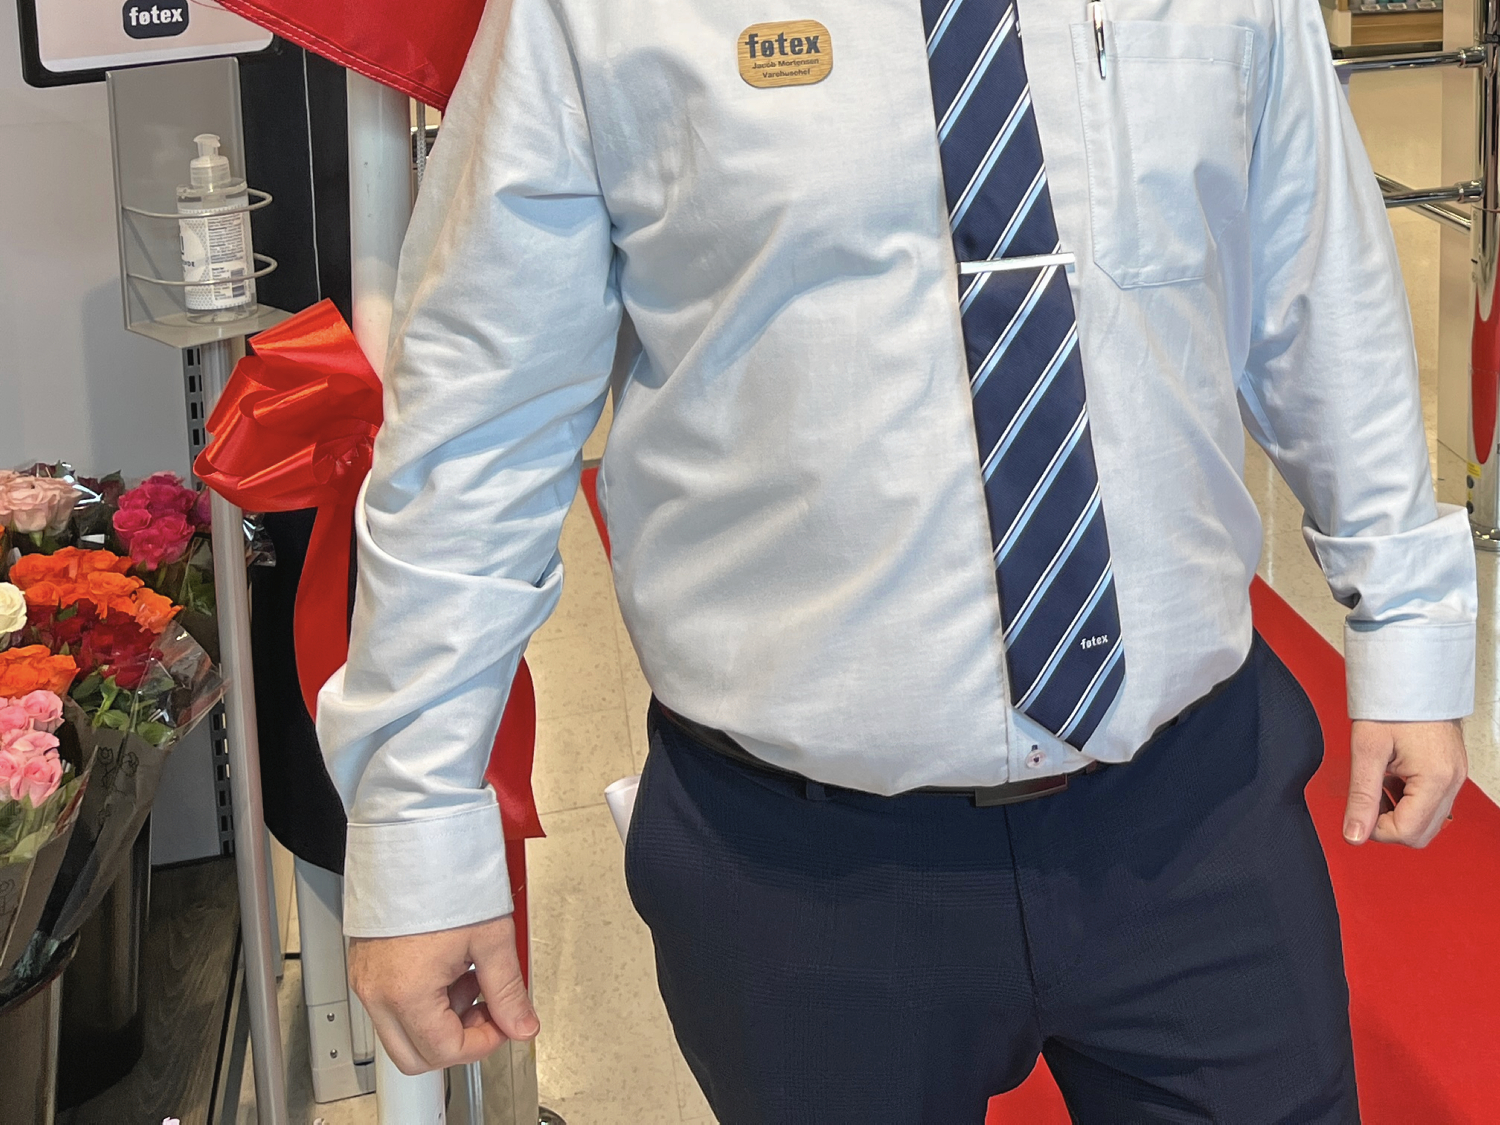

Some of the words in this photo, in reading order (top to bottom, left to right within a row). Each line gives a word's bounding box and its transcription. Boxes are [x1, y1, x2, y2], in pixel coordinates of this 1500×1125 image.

[129, 5, 183, 27] føtex
[744, 31, 821, 59] føtex
[752, 62, 776, 70] Jacob
[778, 58, 819, 67] Mortensen
